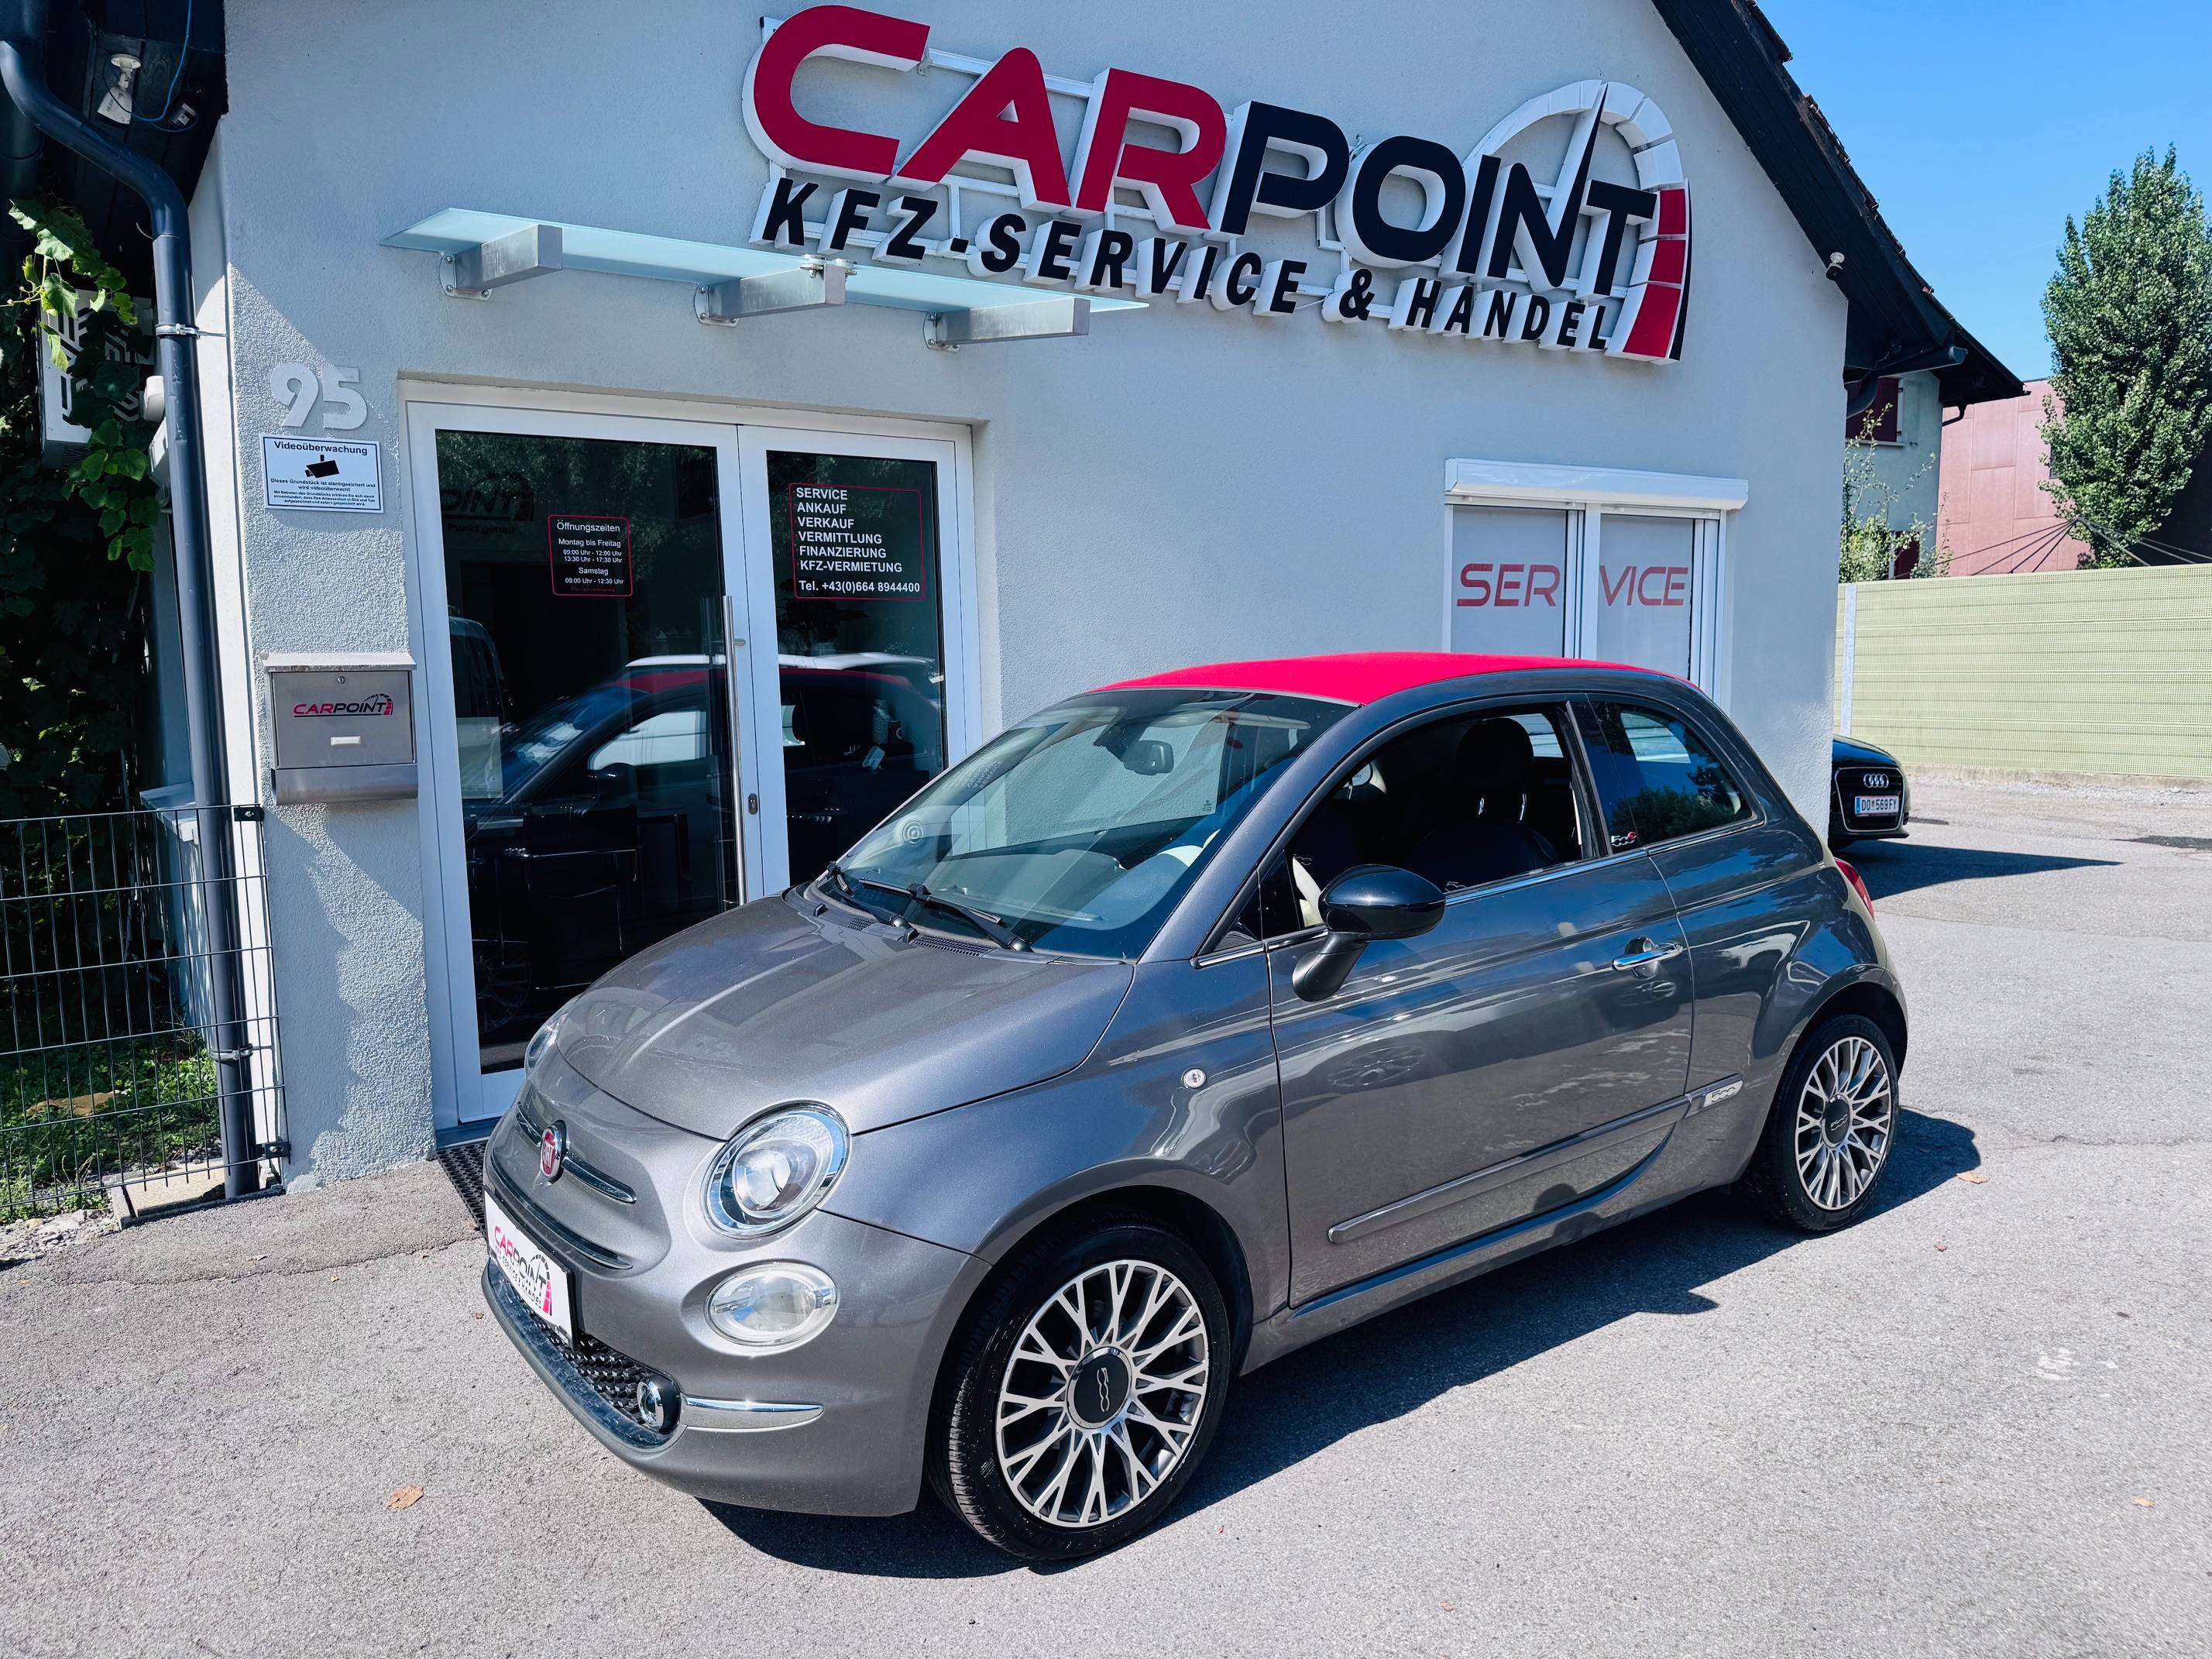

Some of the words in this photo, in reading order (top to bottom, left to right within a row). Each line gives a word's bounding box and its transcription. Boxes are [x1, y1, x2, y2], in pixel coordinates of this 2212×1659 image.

[750, 3, 1659, 297] CARPOINT
[1338, 267, 1376, 321] &
[1406, 277, 1608, 350] HANDEL
[271, 362, 369, 431] 95
[273, 441, 368, 456] Videoüberwachung
[796, 487, 848, 500] SERVICE
[796, 503, 847, 514] ANKAUF
[557, 520, 620, 533] Öffnungszeiten
[797, 517, 854, 529] VERKAUF
[558, 538, 584, 547] Montag
[798, 531, 882, 544] VERMITTLUNG
[799, 545, 887, 558] FINANZIERUNG
[578, 567, 609, 575] Samstag
[800, 560, 902, 572] KFZ-VERMIETUNG
[799, 580, 819, 591] Tel.
[822, 581, 875, 593] +43(0)664
[878, 582, 920, 592] 8944400
[293, 702, 387, 714] CARPOINT
[494, 1225, 547, 1297] CARPOINT
